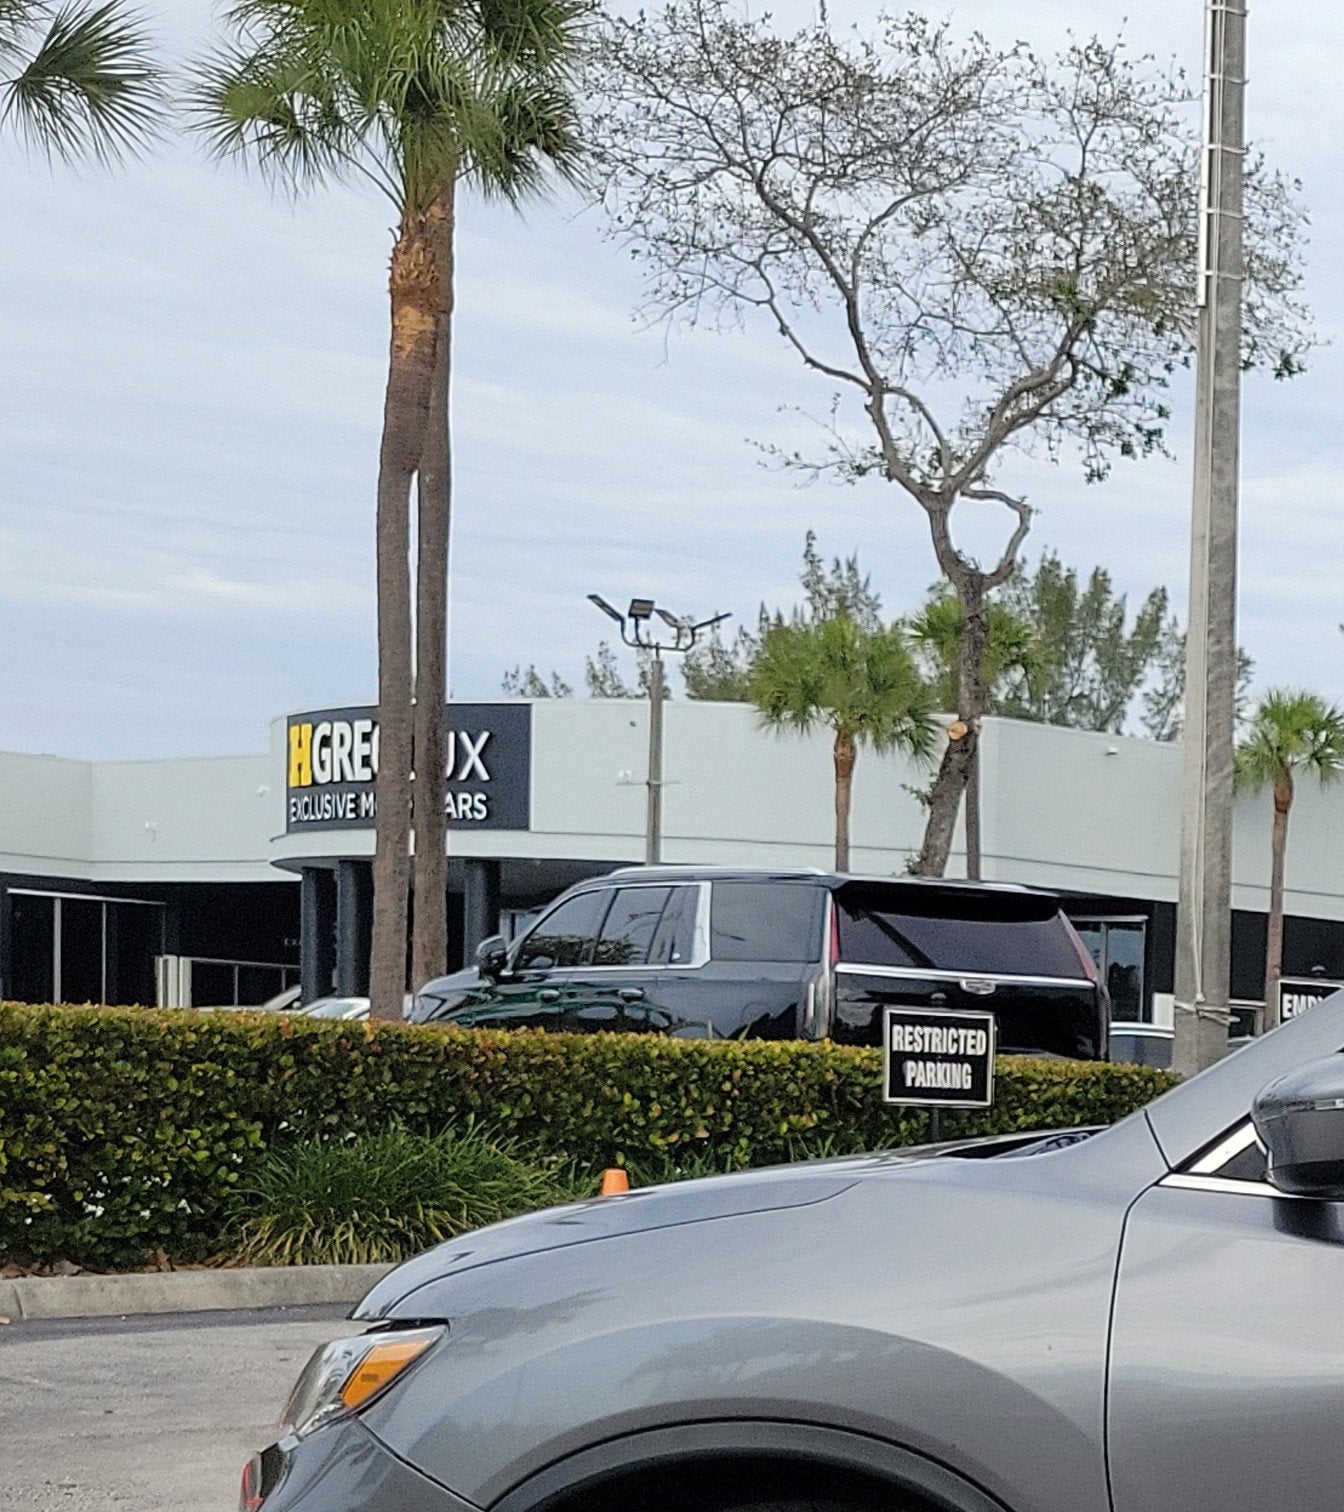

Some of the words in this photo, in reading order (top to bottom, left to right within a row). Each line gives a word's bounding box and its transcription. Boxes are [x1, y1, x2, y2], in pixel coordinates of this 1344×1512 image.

[289, 719, 380, 788] HGRE
[290, 792, 356, 822] EXCLUSIVE
[444, 791, 488, 820] ARS
[892, 1024, 987, 1056] RESTRICTED
[905, 1059, 972, 1090] PARKING
